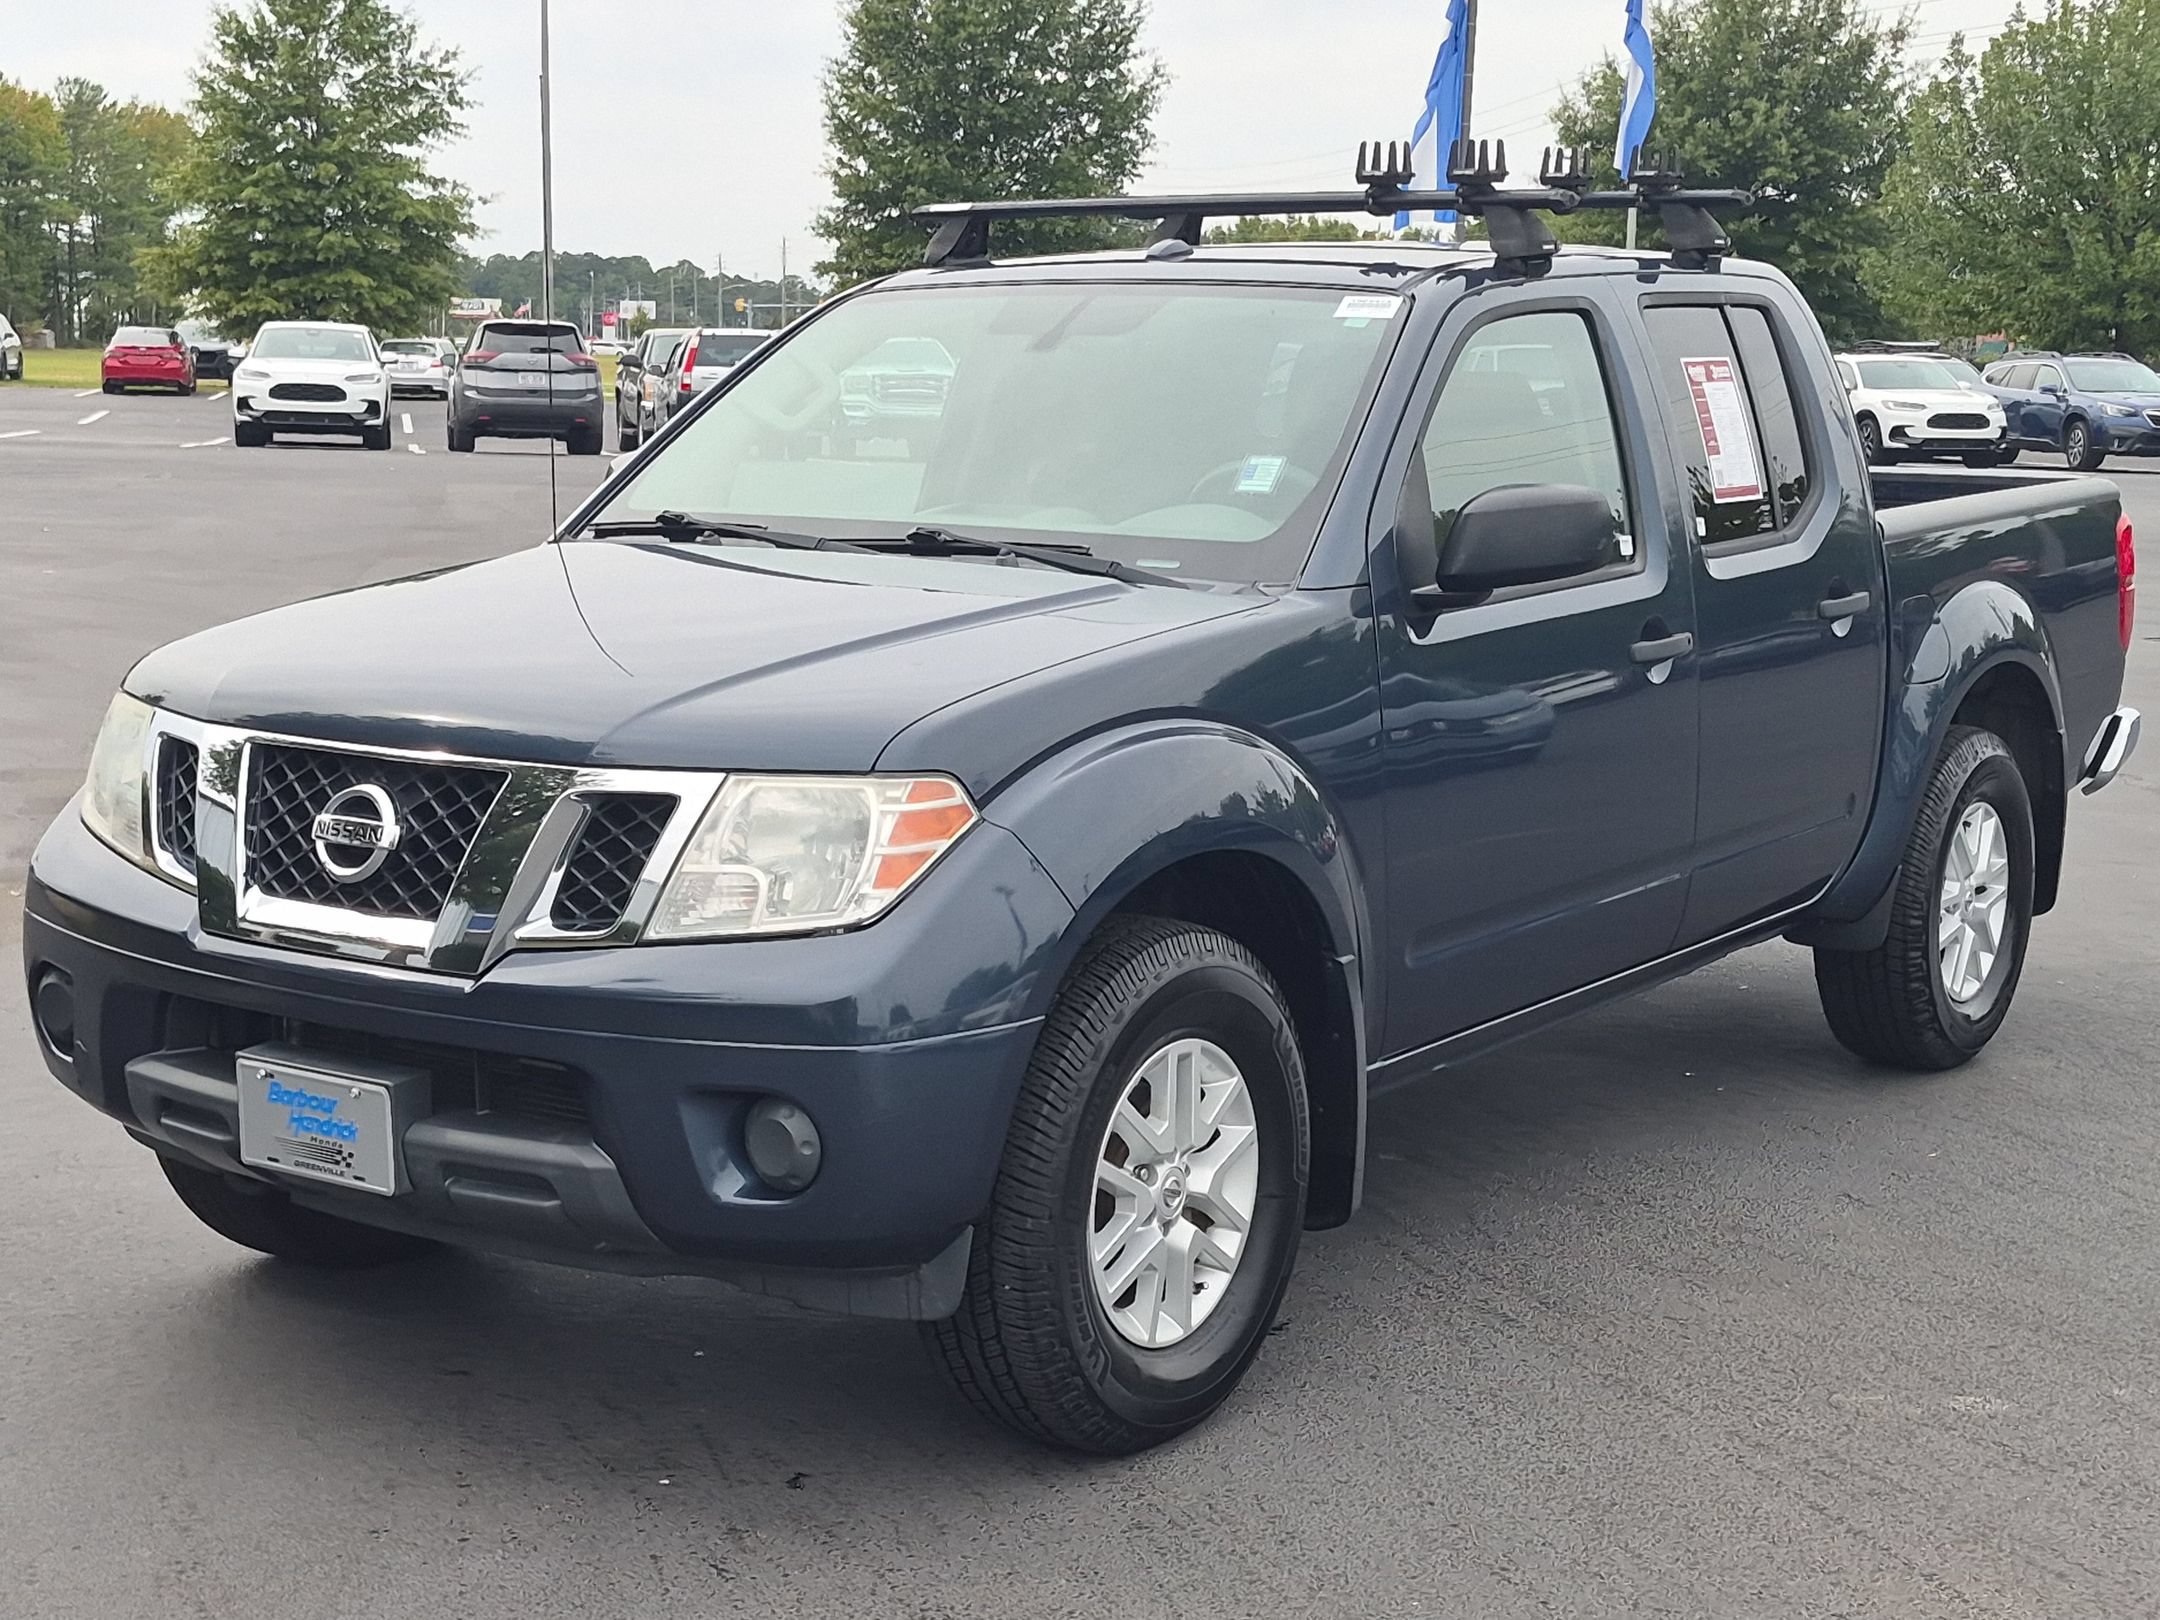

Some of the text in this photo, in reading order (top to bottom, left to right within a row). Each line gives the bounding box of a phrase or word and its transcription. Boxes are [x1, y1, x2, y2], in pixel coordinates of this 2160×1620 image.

[315, 820, 384, 843] NISSAN
[267, 1080, 338, 1113] Barbour
[310, 1136, 343, 1149] Honda
[293, 1159, 346, 1177] GREENVILLE
